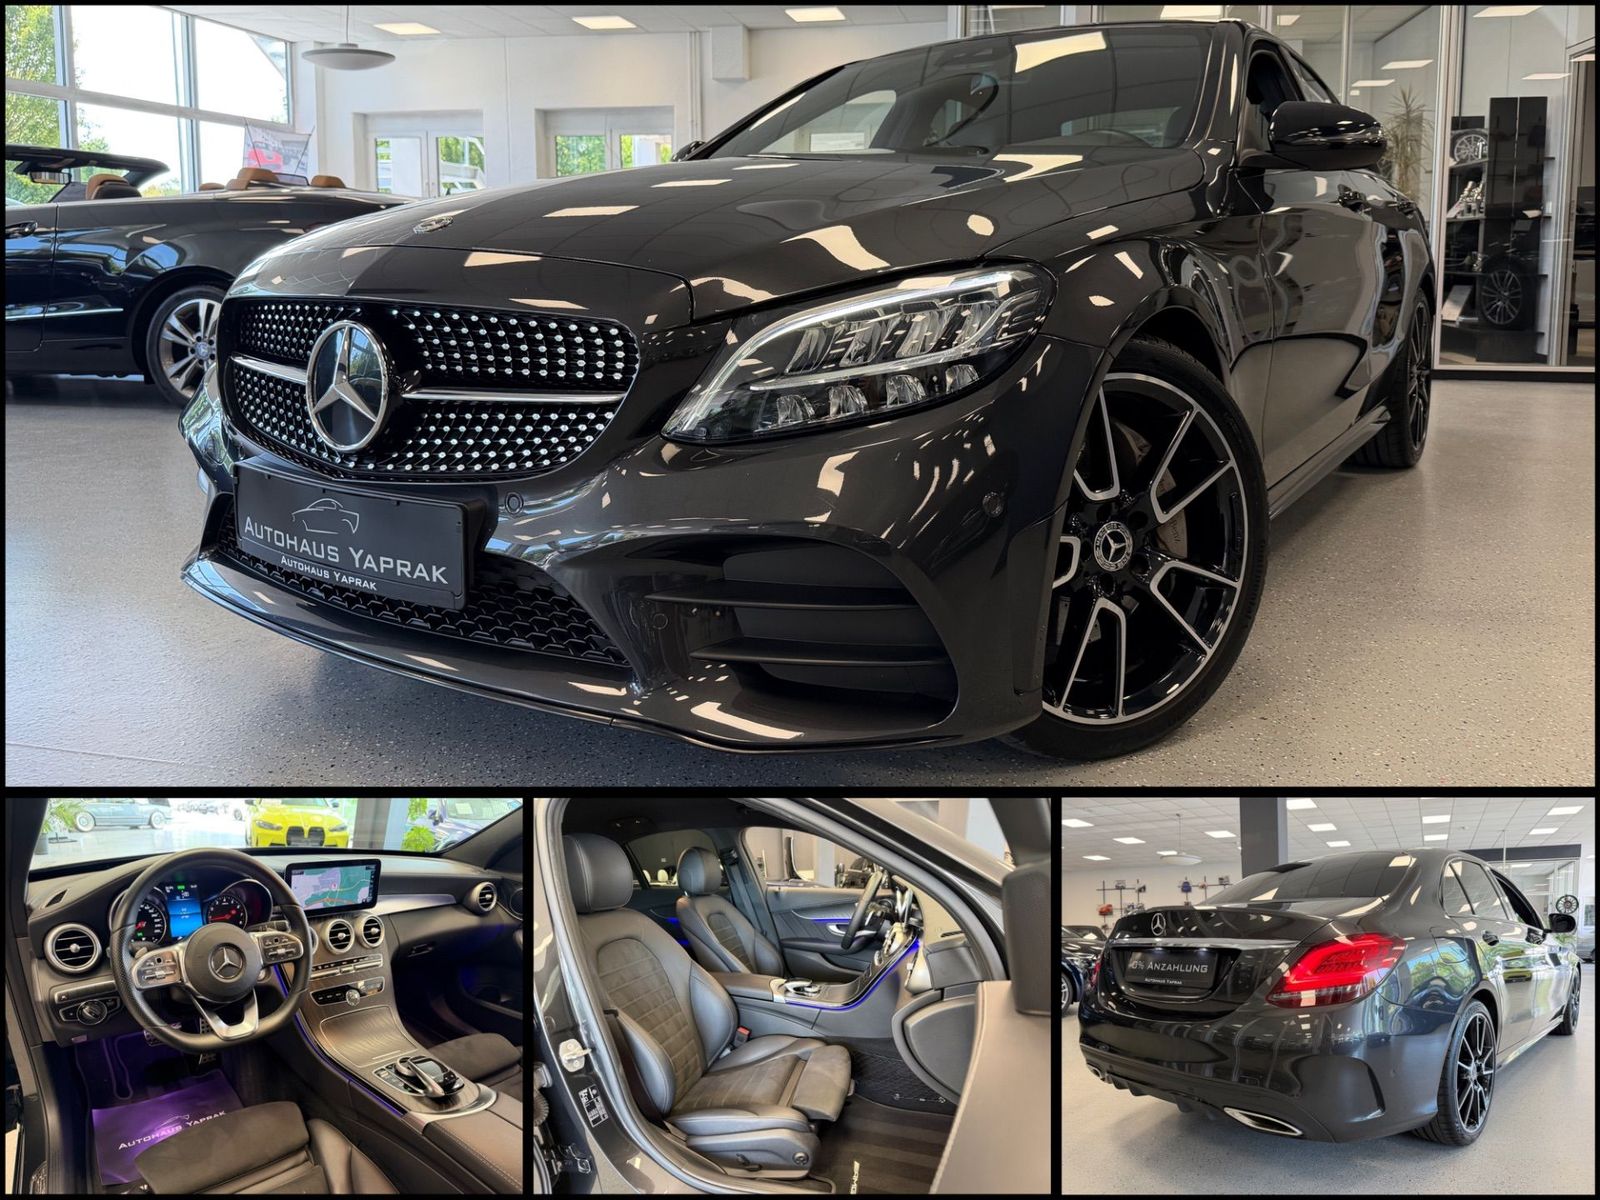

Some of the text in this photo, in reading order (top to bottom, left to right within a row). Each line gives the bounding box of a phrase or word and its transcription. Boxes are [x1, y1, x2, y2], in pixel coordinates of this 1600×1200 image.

[244, 516, 449, 585] AUTOHAUS YAPRAK
[280, 555, 377, 591] AUTOHAUS YAPRAK
[1147, 962, 1209, 973] ANZAHLUNG
[118, 1110, 226, 1151] AUTOHAUS YAPRAK
